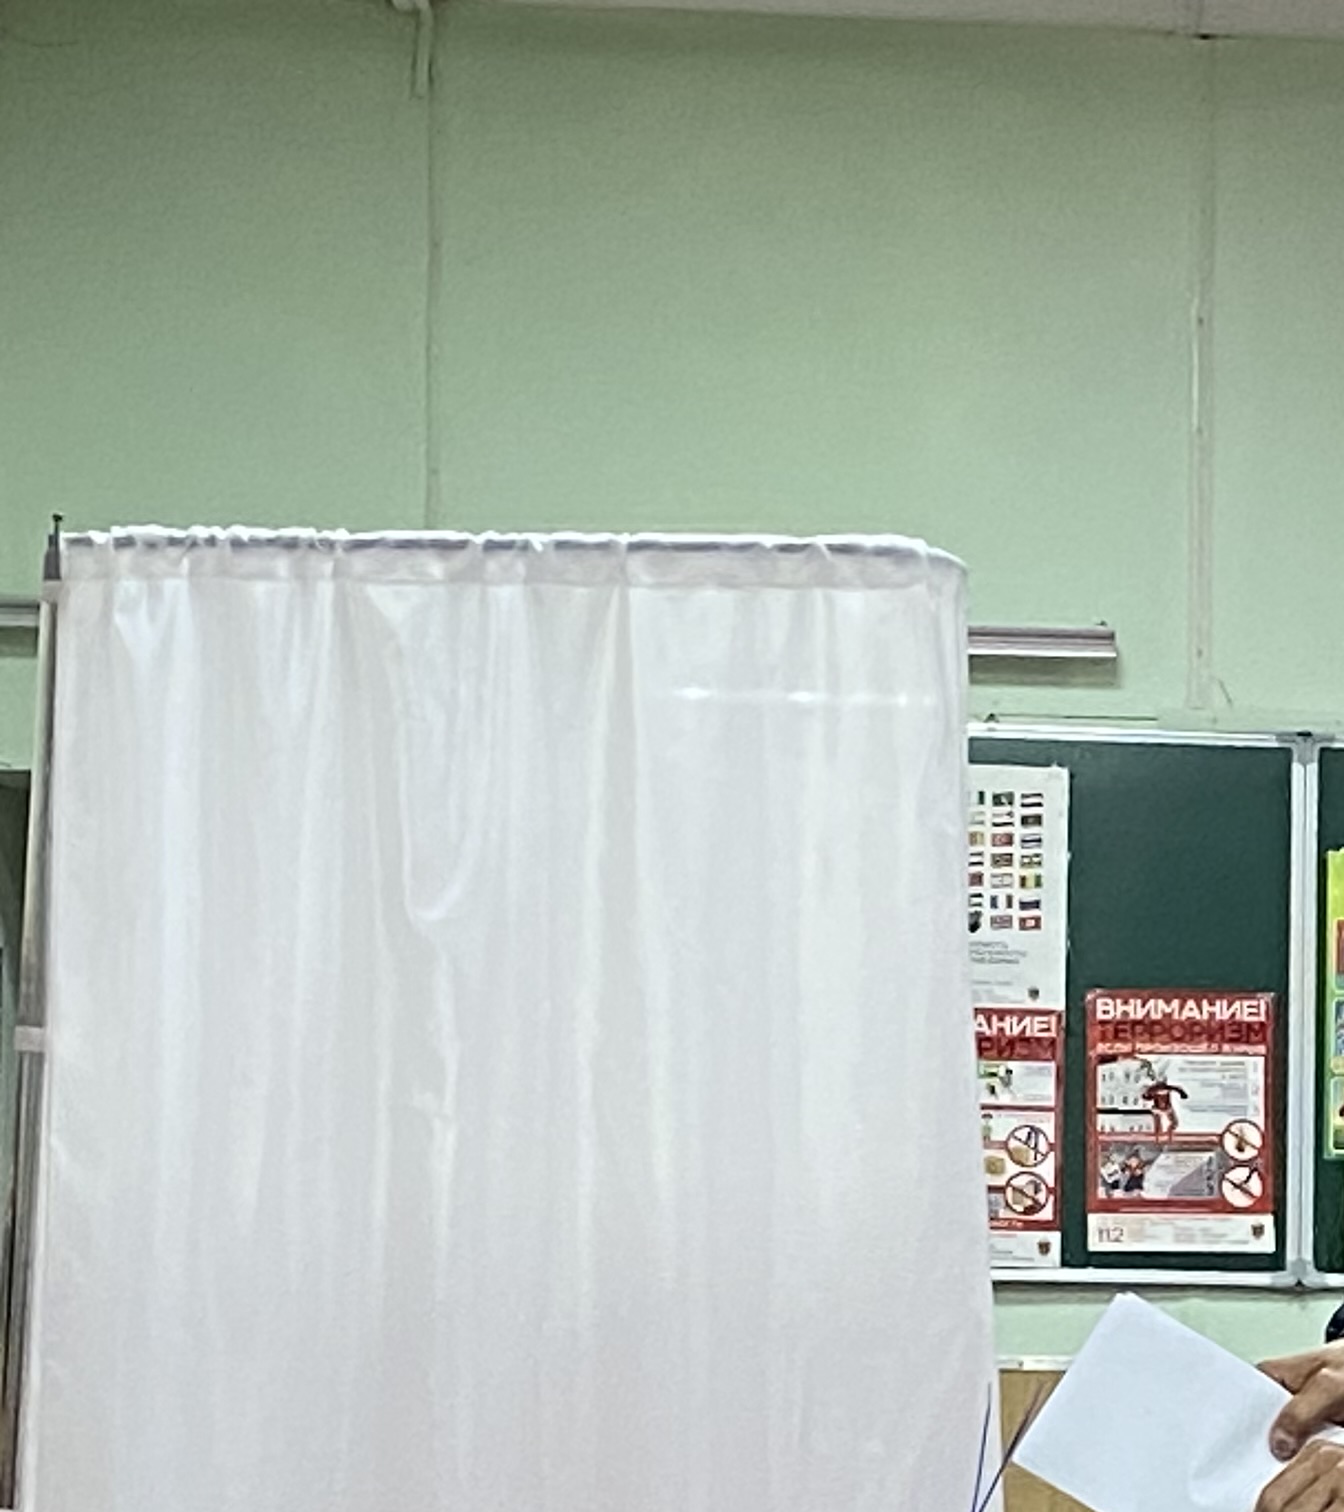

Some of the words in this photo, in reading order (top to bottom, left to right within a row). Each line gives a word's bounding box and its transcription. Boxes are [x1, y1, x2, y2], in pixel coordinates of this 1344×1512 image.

[1095, 997, 1267, 1022] ВНИМАНИЕ!
[975, 1013, 1058, 1038] АНИЕ!
[1096, 1021, 1266, 1043] ТЕРРОРИЗМ
